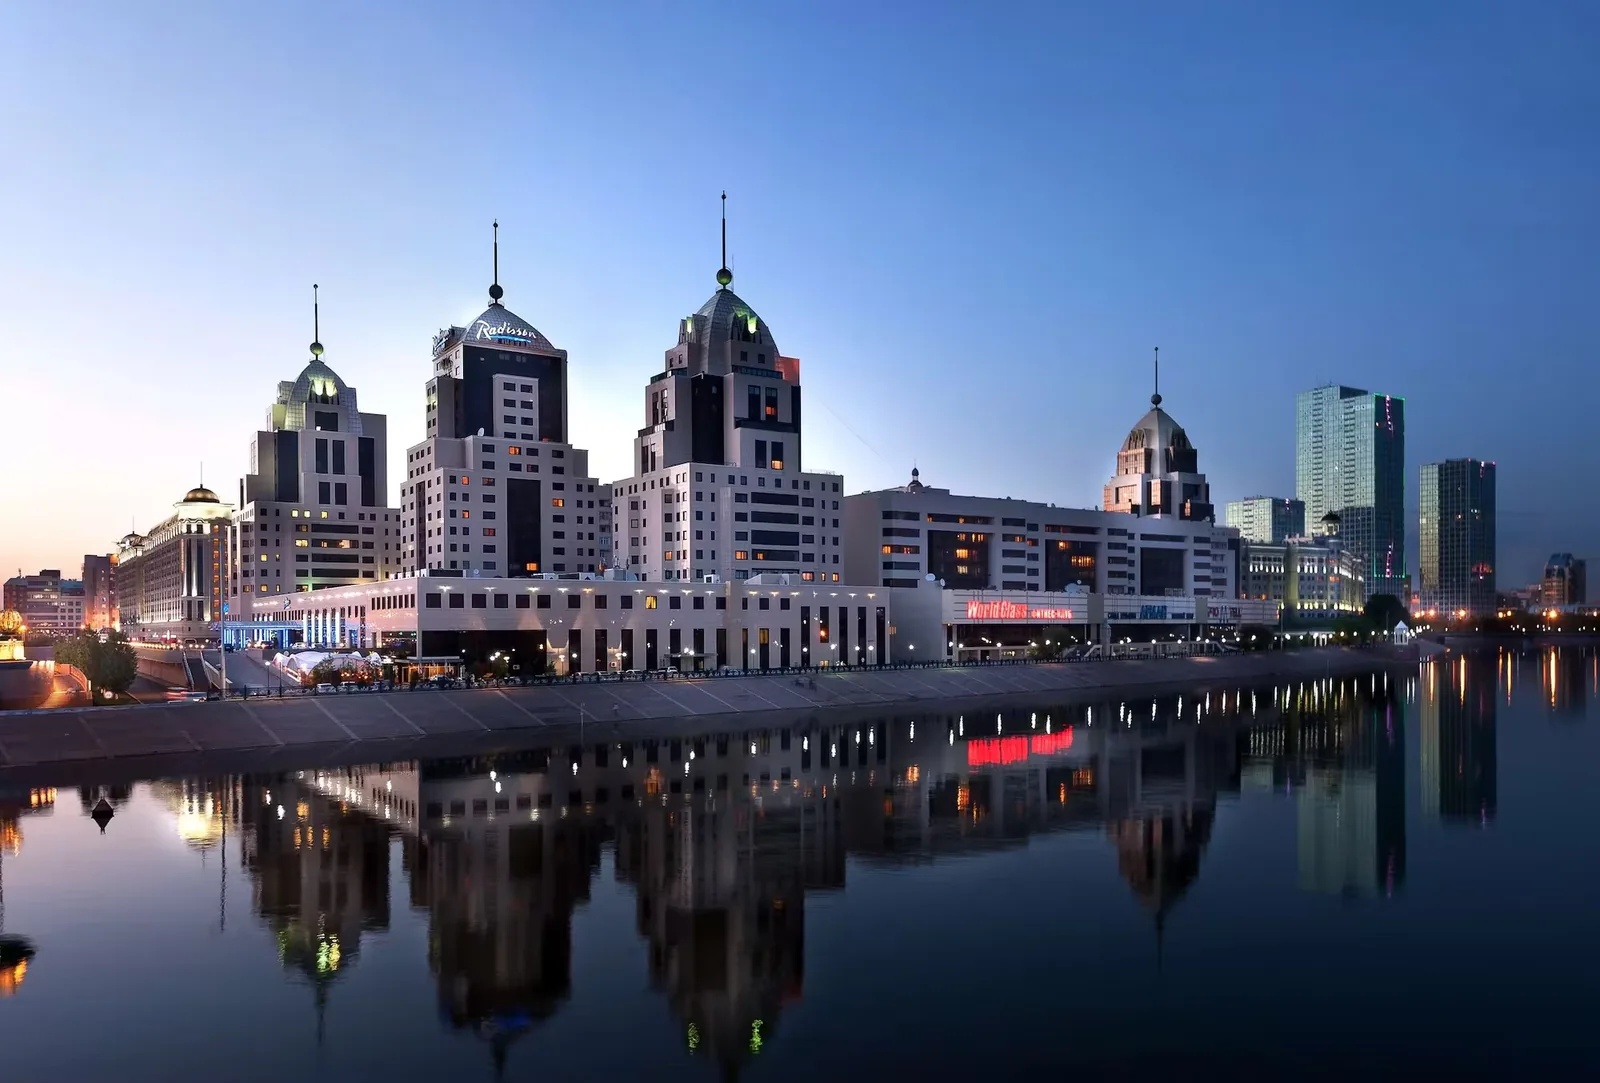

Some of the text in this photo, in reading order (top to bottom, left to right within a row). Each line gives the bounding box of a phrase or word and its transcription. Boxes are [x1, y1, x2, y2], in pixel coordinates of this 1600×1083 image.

[476, 320, 537, 340] Radisson
[967, 600, 1027, 619] World Class
